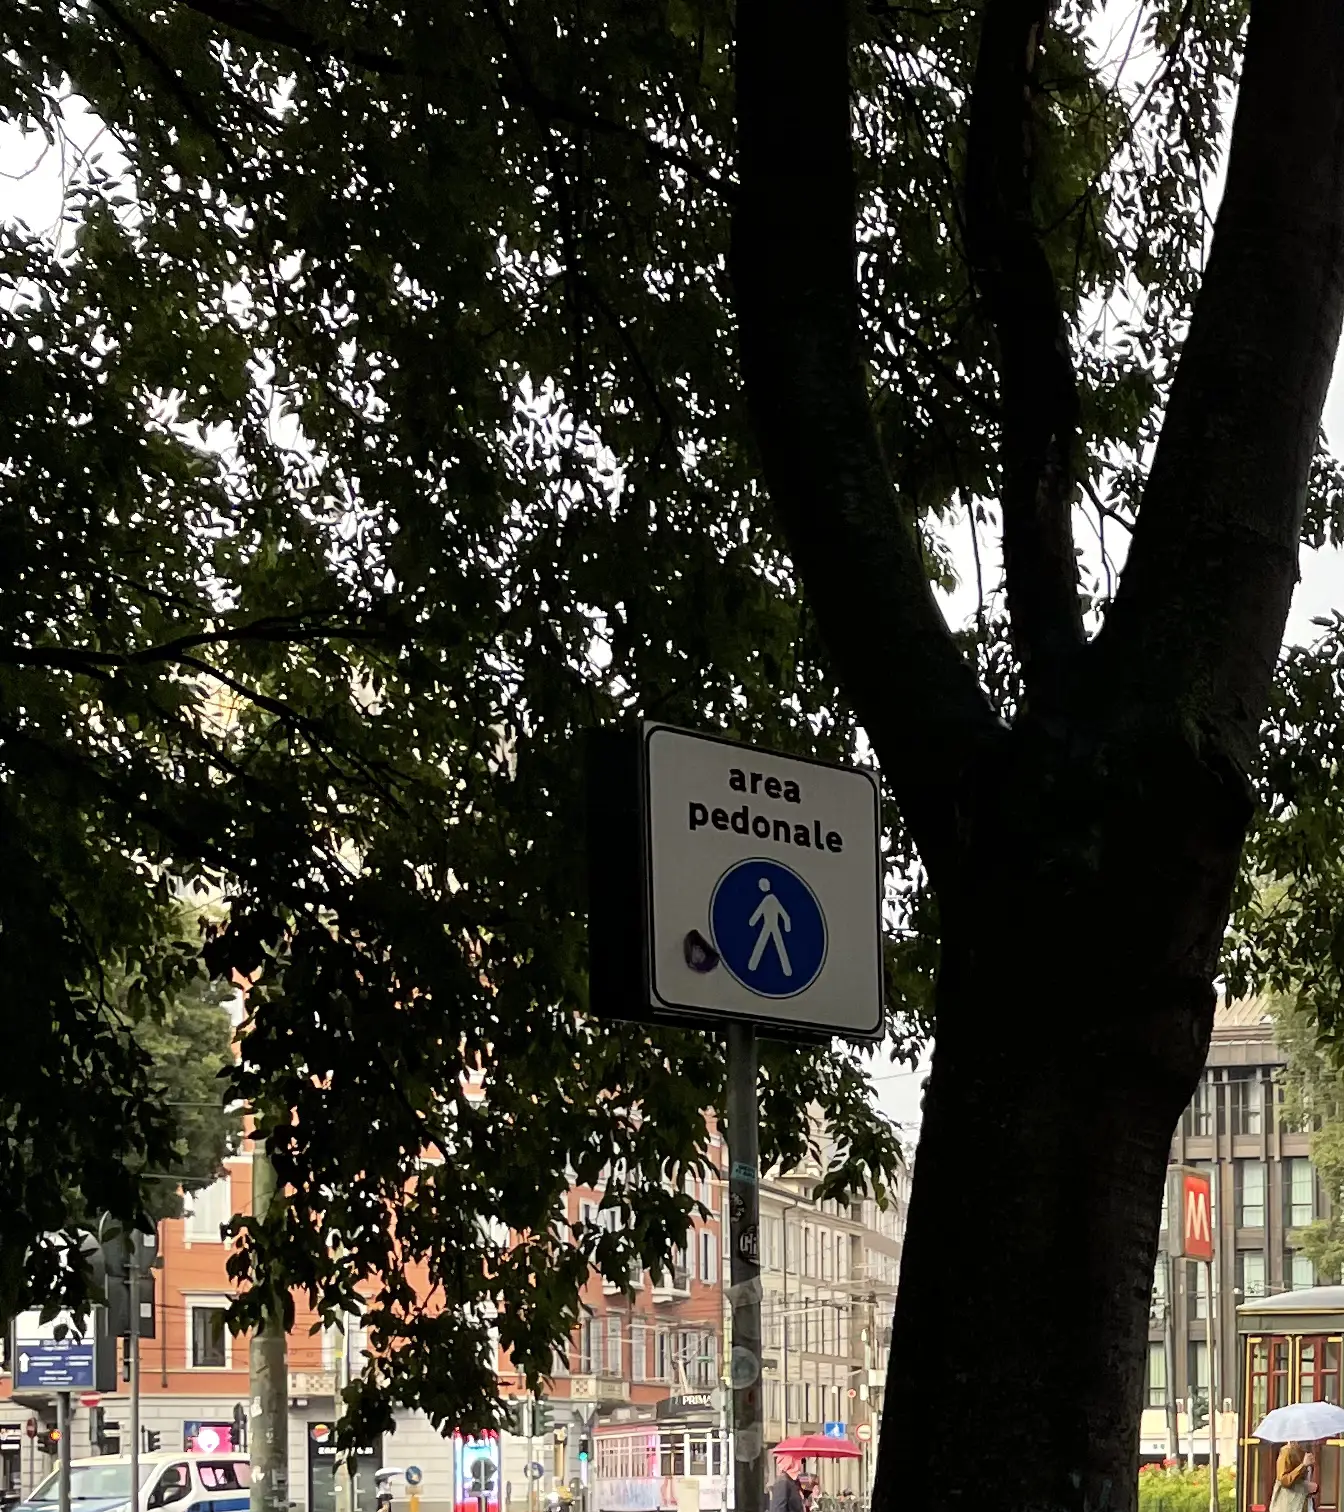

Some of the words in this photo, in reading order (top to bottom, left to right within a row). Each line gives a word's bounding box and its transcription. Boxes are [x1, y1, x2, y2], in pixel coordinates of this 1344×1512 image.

[729, 769, 801, 804] area
[689, 801, 843, 853] pedonale
[1186, 1190, 1210, 1242] M
